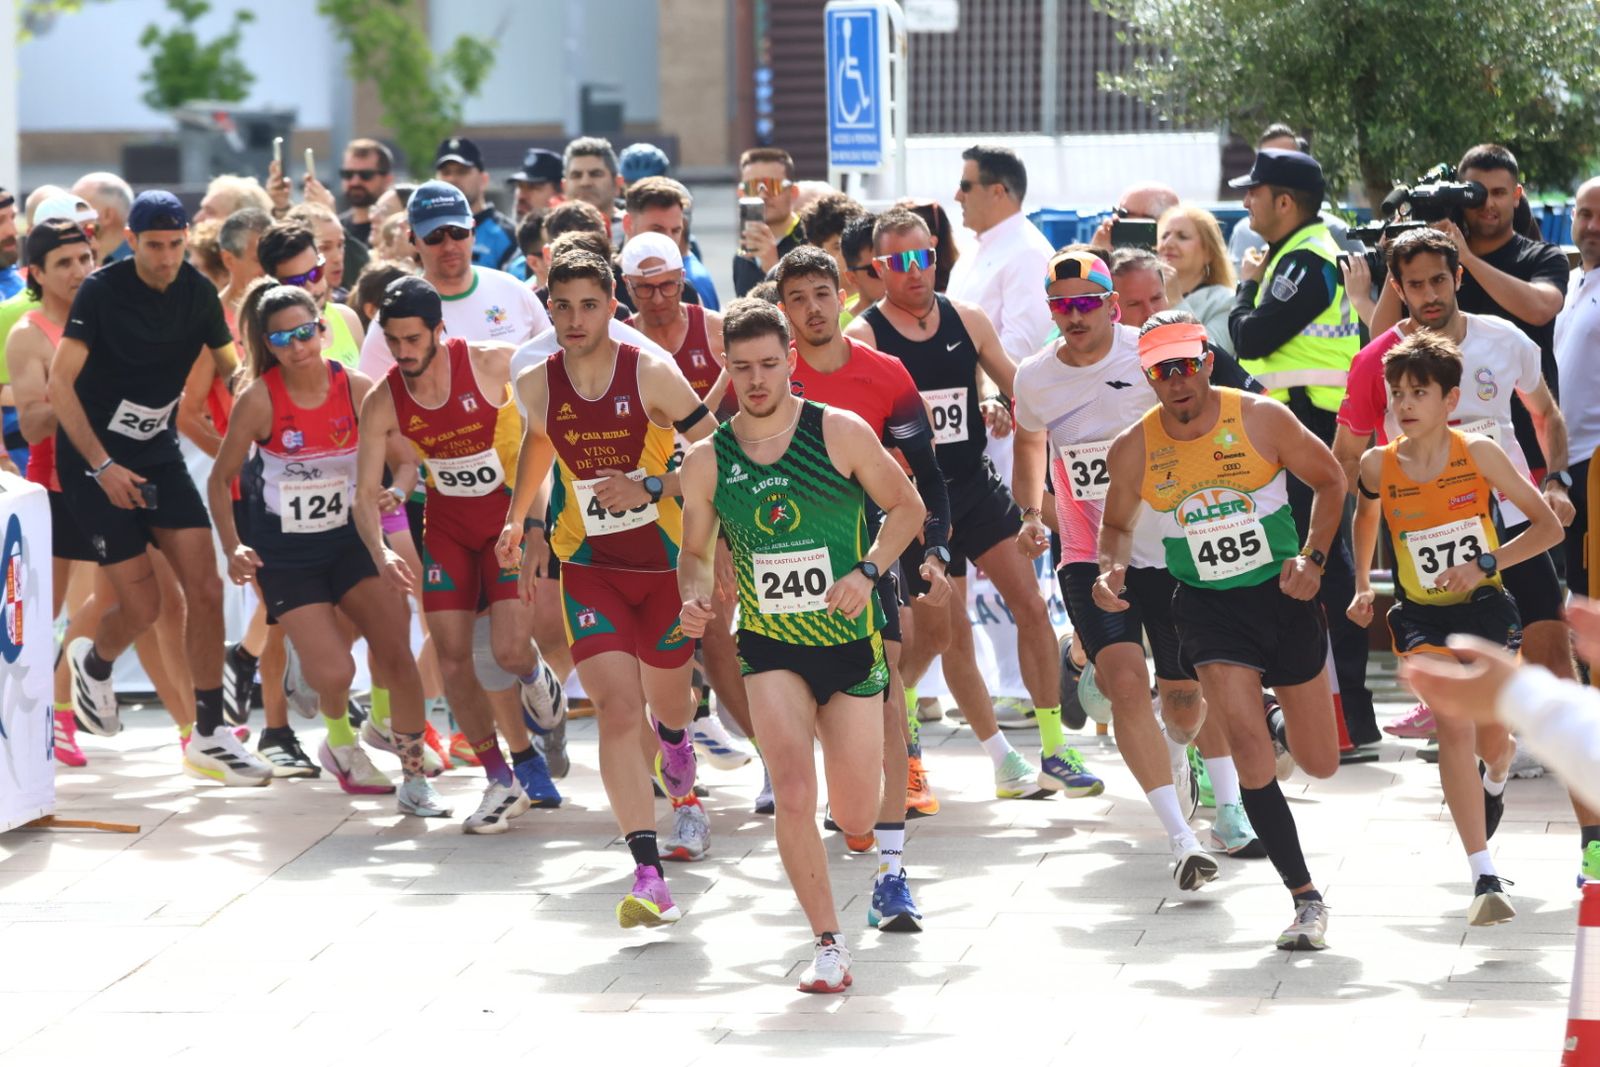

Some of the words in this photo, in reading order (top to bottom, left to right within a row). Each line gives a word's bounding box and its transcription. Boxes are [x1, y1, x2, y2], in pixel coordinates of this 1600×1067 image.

[602, 429, 631, 440] RURAL
[584, 446, 616, 456] VINO
[576, 458, 593, 469] DE
[594, 454, 630, 466] TORO
[438, 466, 496, 487] 990
[751, 477, 789, 494] LUCUS
[289, 492, 342, 520] 124
[1184, 499, 1249, 524] ALCER
[1208, 523, 1235, 533] CASTILLA
[1240, 517, 1255, 526] LEÓN
[1428, 528, 1455, 539] CASTILLA
[1461, 521, 1477, 530] LEÓN
[1198, 530, 1261, 566] 485
[1419, 535, 1482, 574] 373
[774, 557, 802, 565] CASTILLA
[807, 553, 825, 561] LEÓN
[762, 567, 827, 599] 240
